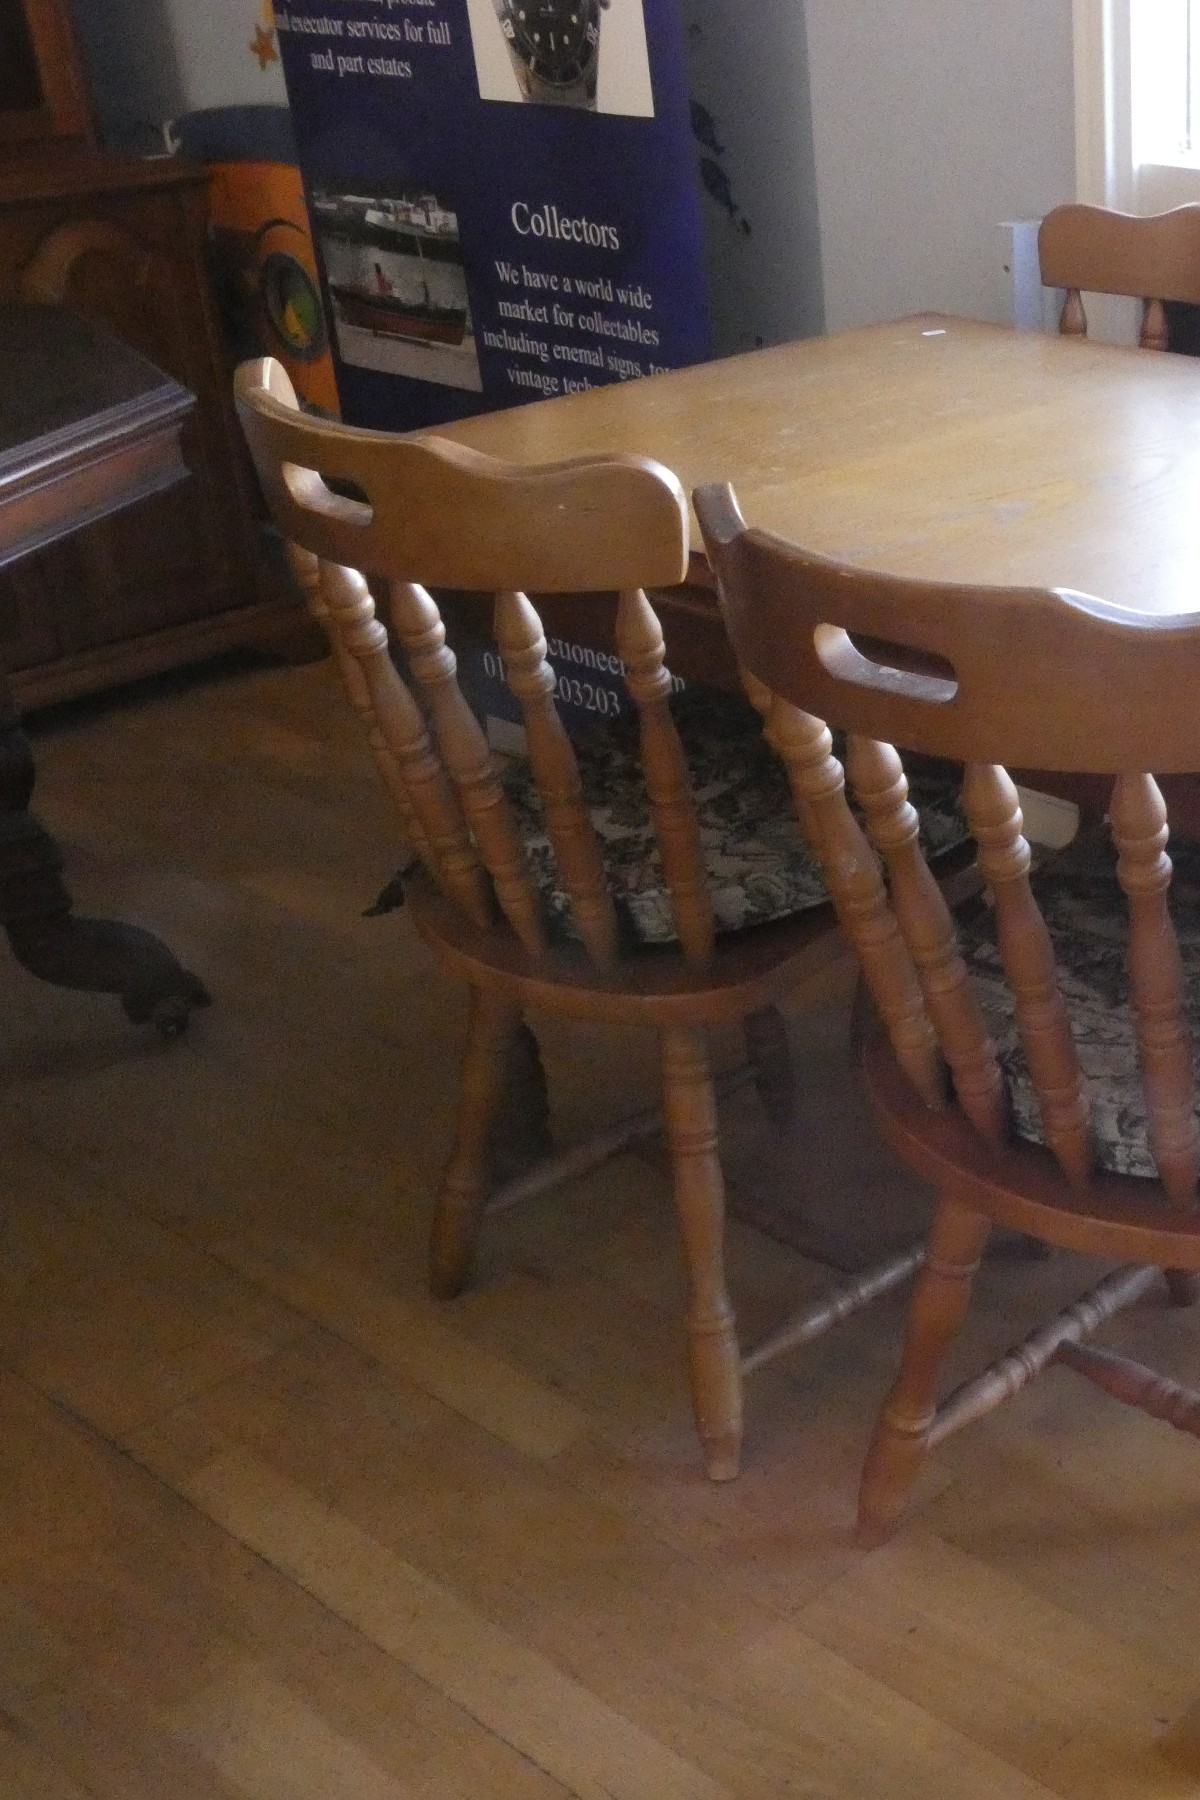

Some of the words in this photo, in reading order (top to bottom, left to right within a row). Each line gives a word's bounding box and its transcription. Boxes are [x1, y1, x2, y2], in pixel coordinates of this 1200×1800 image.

[291, 15, 344, 36] executor
[347, 16, 401, 41] services
[404, 18, 423, 43] for
[427, 20, 451, 45] full
[310, 48, 334, 71] and
[337, 54, 365, 78] part
[367, 56, 412, 78] estates
[511, 201, 620, 250] Collectors
[494, 261, 519, 285] We
[521, 265, 559, 291] have
[562, 276, 572, 293] a
[574, 277, 614, 302] world
[616, 284, 653, 310] wide
[498, 299, 549, 324] market
[552, 303, 575, 329] for
[578, 311, 660, 346] collectables
[483, 325, 550, 363] including
[552, 343, 604, 368] enemal
[506, 363, 559, 396] vintage
